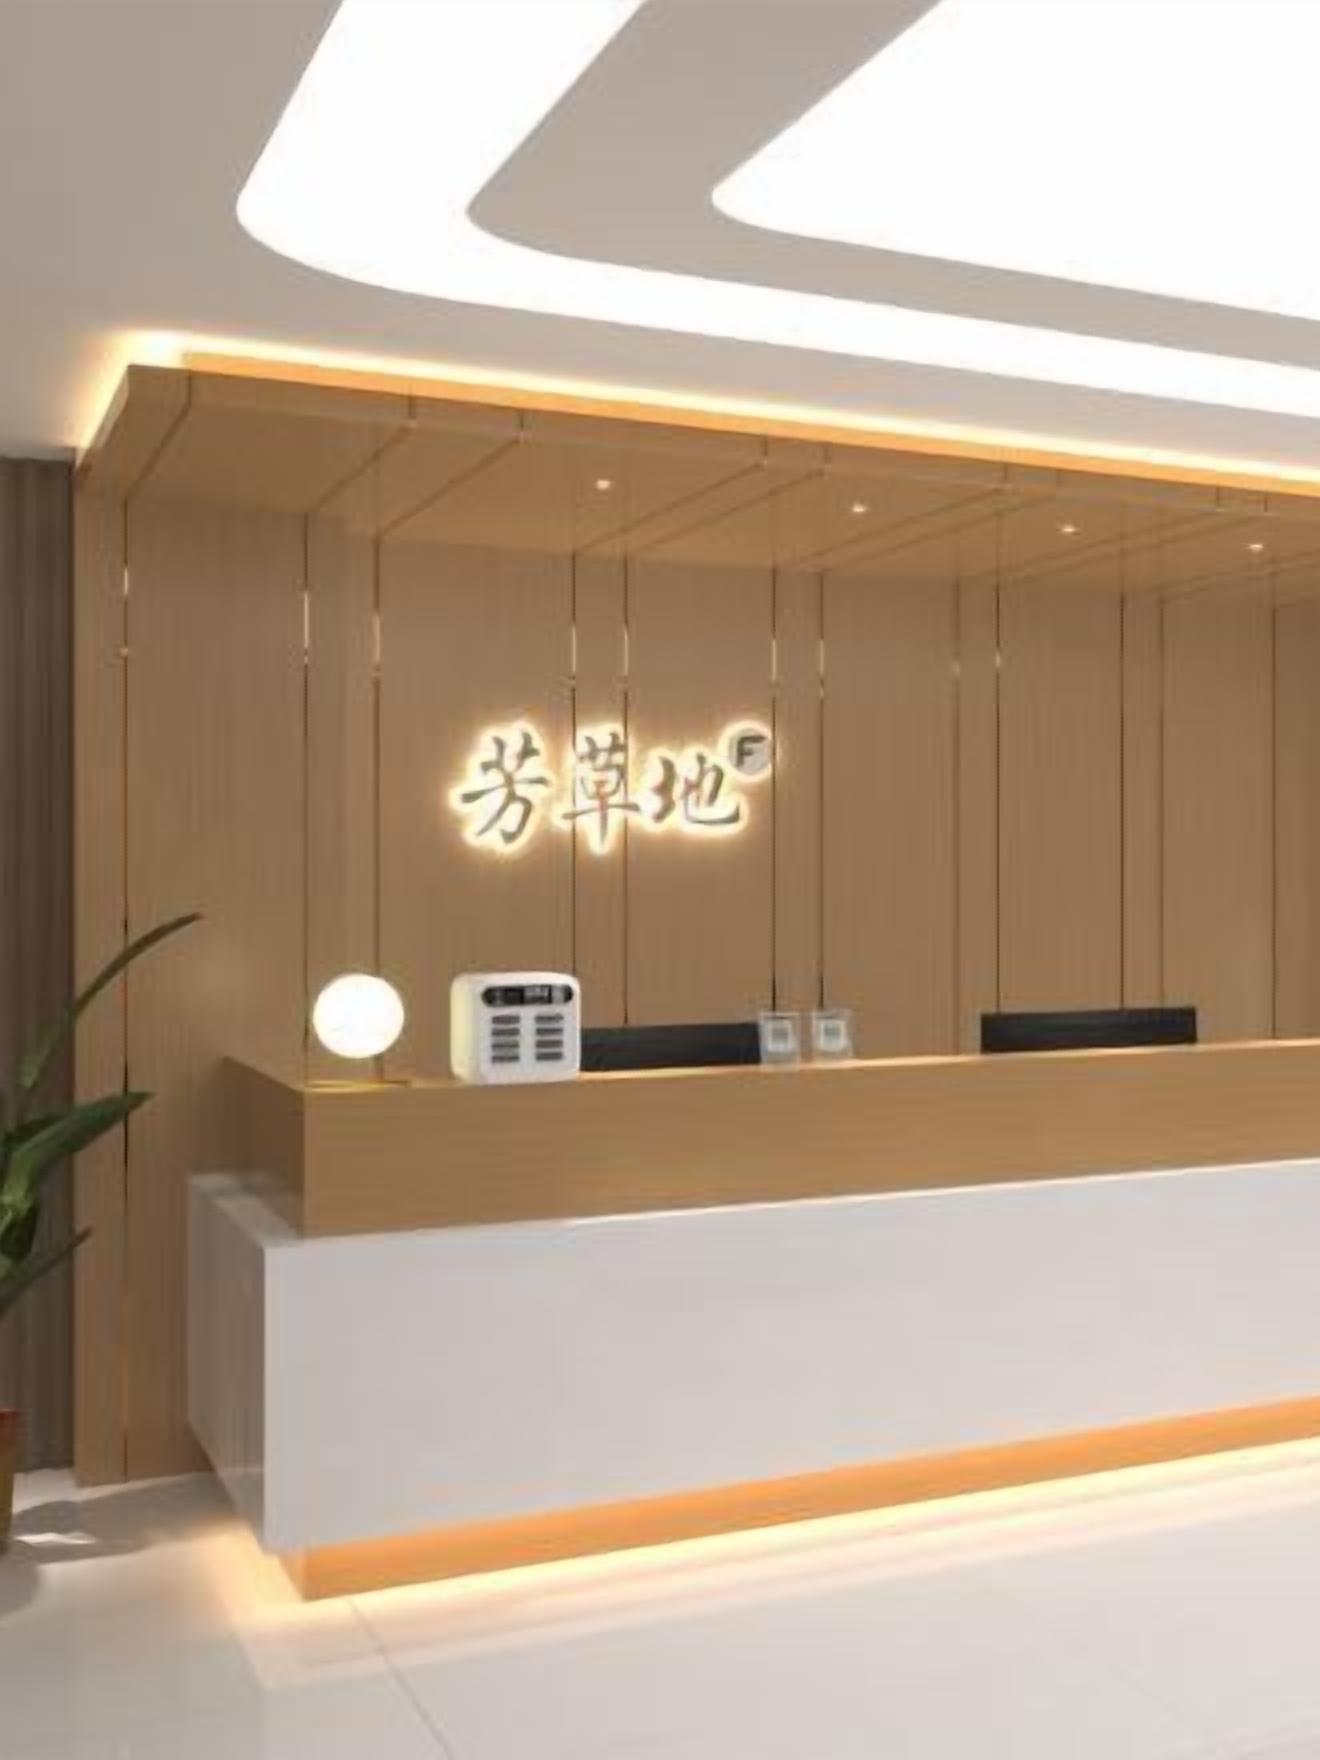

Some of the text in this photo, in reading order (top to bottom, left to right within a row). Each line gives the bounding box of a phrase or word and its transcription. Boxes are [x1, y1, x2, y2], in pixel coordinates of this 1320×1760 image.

[460, 729, 740, 844] 芳草地
[736, 735, 767, 766] F
